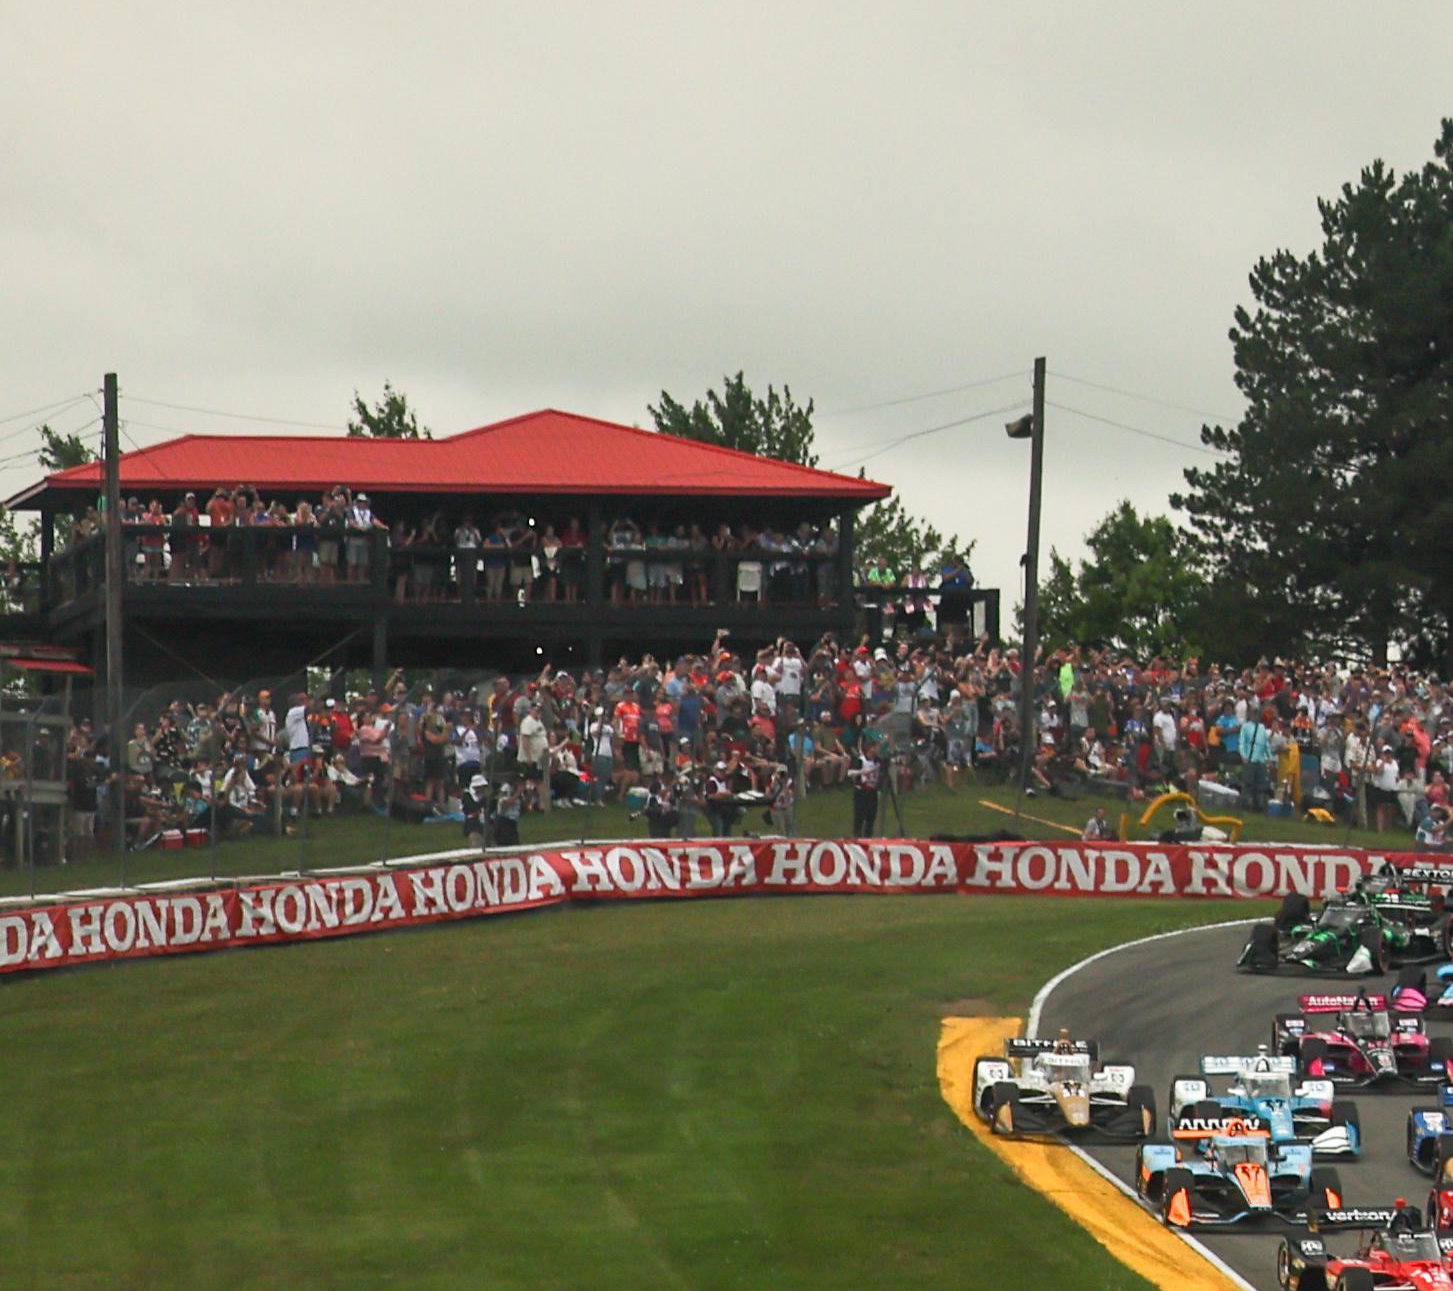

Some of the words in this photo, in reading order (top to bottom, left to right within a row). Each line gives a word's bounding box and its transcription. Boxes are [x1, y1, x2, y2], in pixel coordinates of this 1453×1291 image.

[68, 895, 230, 955] HONDA
[236, 875, 404, 937] HONDA
[407, 855, 562, 916] HONDA
[561, 844, 757, 892] HONDA
[765, 842, 959, 887] HONDA
[966, 844, 1177, 895] HONDA
[1326, 1209, 1391, 1221] verizon
